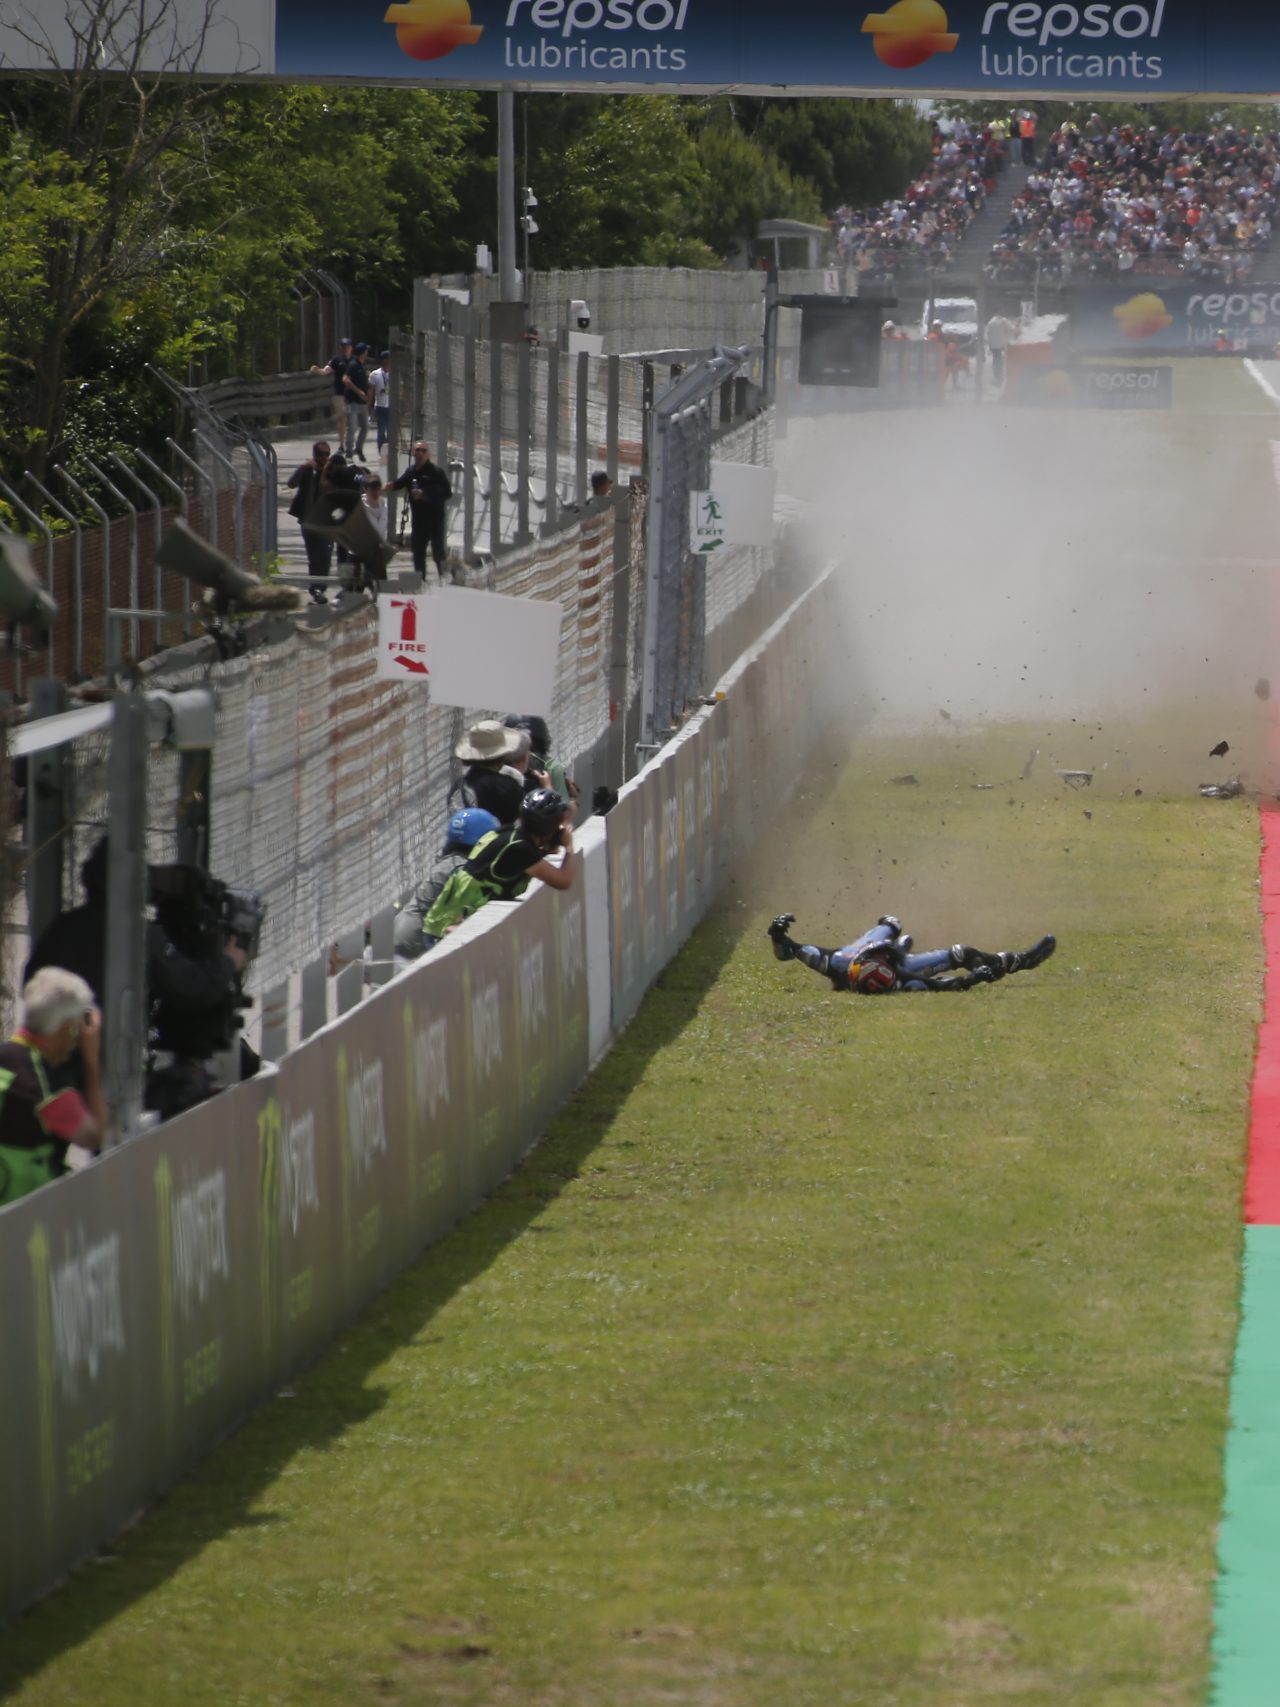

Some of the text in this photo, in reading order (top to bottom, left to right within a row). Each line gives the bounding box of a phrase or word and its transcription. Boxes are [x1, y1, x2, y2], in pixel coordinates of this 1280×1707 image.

[505, 0, 690, 37] repsol
[981, 0, 1165, 45] repsol
[505, 37, 687, 71] lubricants
[981, 45, 1163, 79] lubricants
[1085, 370, 1159, 391] repsol
[388, 642, 426, 653] FIRE
